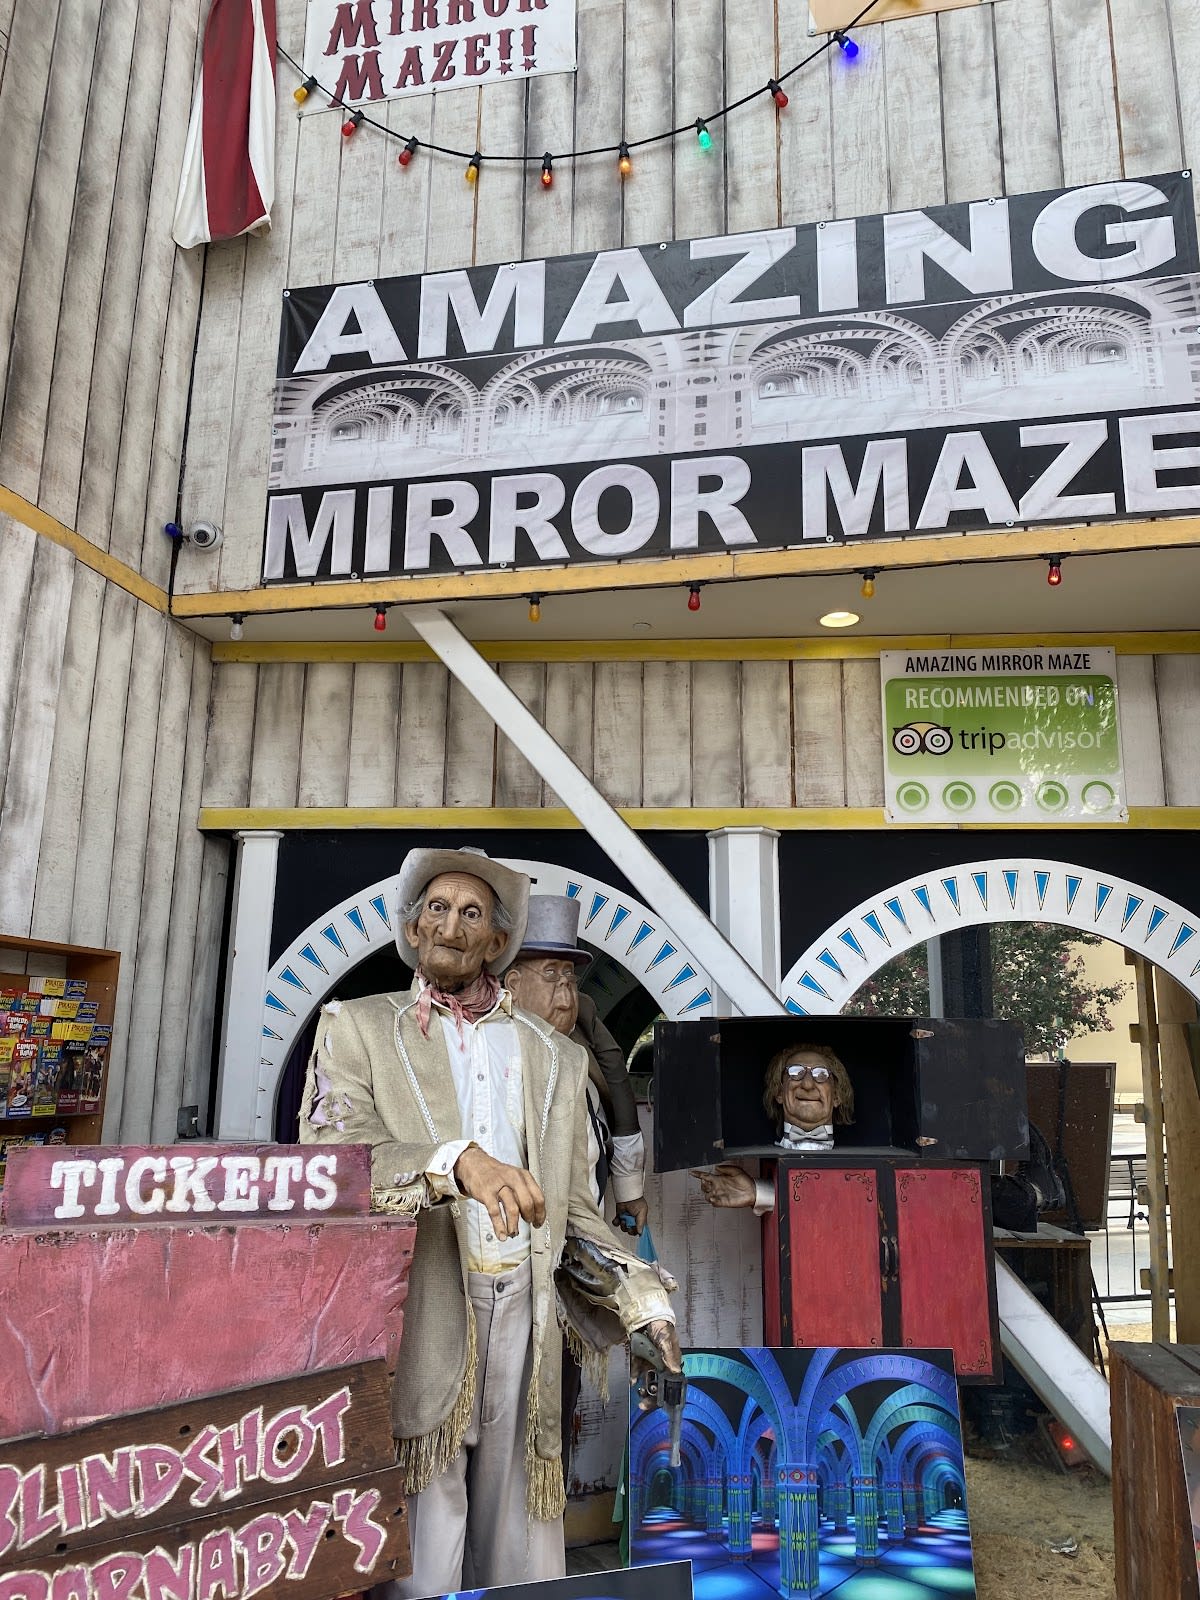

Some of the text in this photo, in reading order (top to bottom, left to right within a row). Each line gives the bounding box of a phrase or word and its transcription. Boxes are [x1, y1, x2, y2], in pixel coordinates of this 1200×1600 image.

[327, 24, 539, 108] MAZE!!
[293, 181, 1177, 373] AMAZING
[263, 410, 1200, 580] MIRROR MAZE
[905, 653, 1091, 673] AMAZING MIRROR MAZE
[905, 684, 1095, 709] RECOMMENDED ON
[959, 725, 1103, 755] tripadvisor
[50, 1155, 338, 1219] TICKETS
